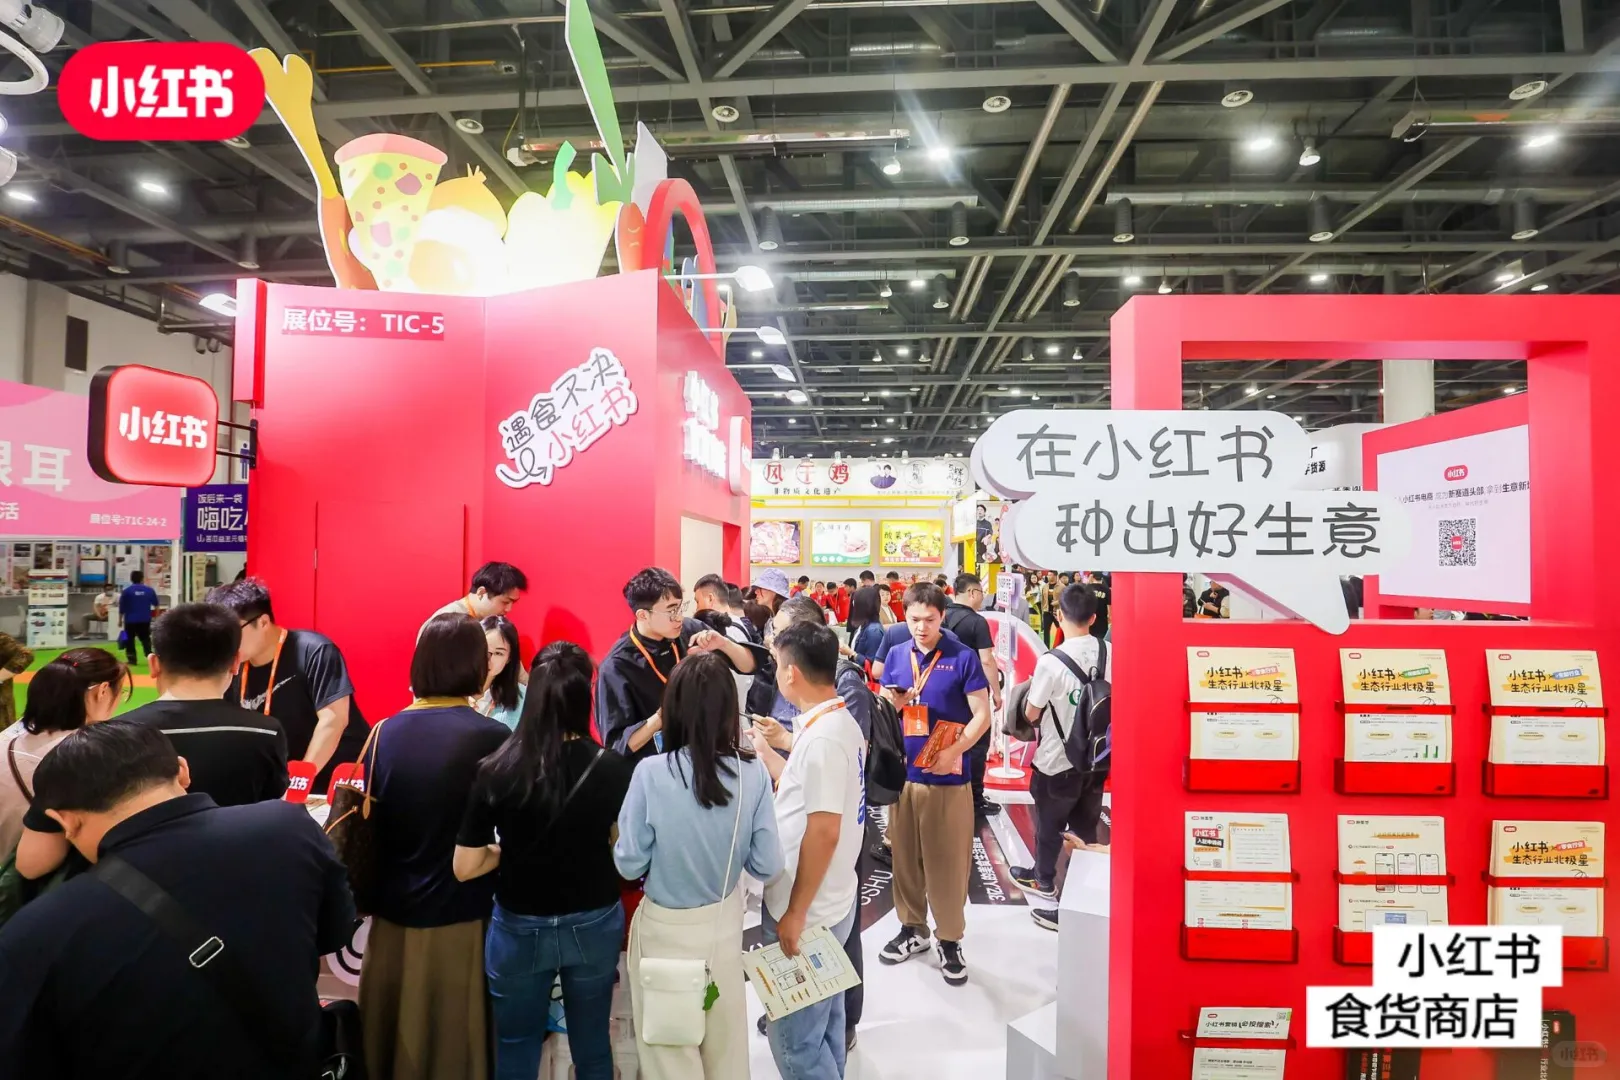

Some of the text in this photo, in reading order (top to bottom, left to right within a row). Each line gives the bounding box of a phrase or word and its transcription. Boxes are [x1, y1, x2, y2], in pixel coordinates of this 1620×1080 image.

[503, 353, 618, 453] 遇食不决
[119, 406, 209, 449] 小红书
[549, 381, 631, 461] 小红书
[1016, 423, 1275, 482] 在小红书
[1056, 499, 1381, 559] 种出好生意
[1207, 666, 1243, 679] 小红书
[1360, 668, 1396, 681] 小红书
[1509, 669, 1546, 682] 小红书
[1208, 680, 1284, 692] 生态行业北极星
[1360, 681, 1436, 693] 生态行业北极星
[1511, 682, 1588, 695] 生态行业北极星
[1512, 840, 1549, 854] 小红书
[1512, 854, 1589, 867] 生态行业北极星
